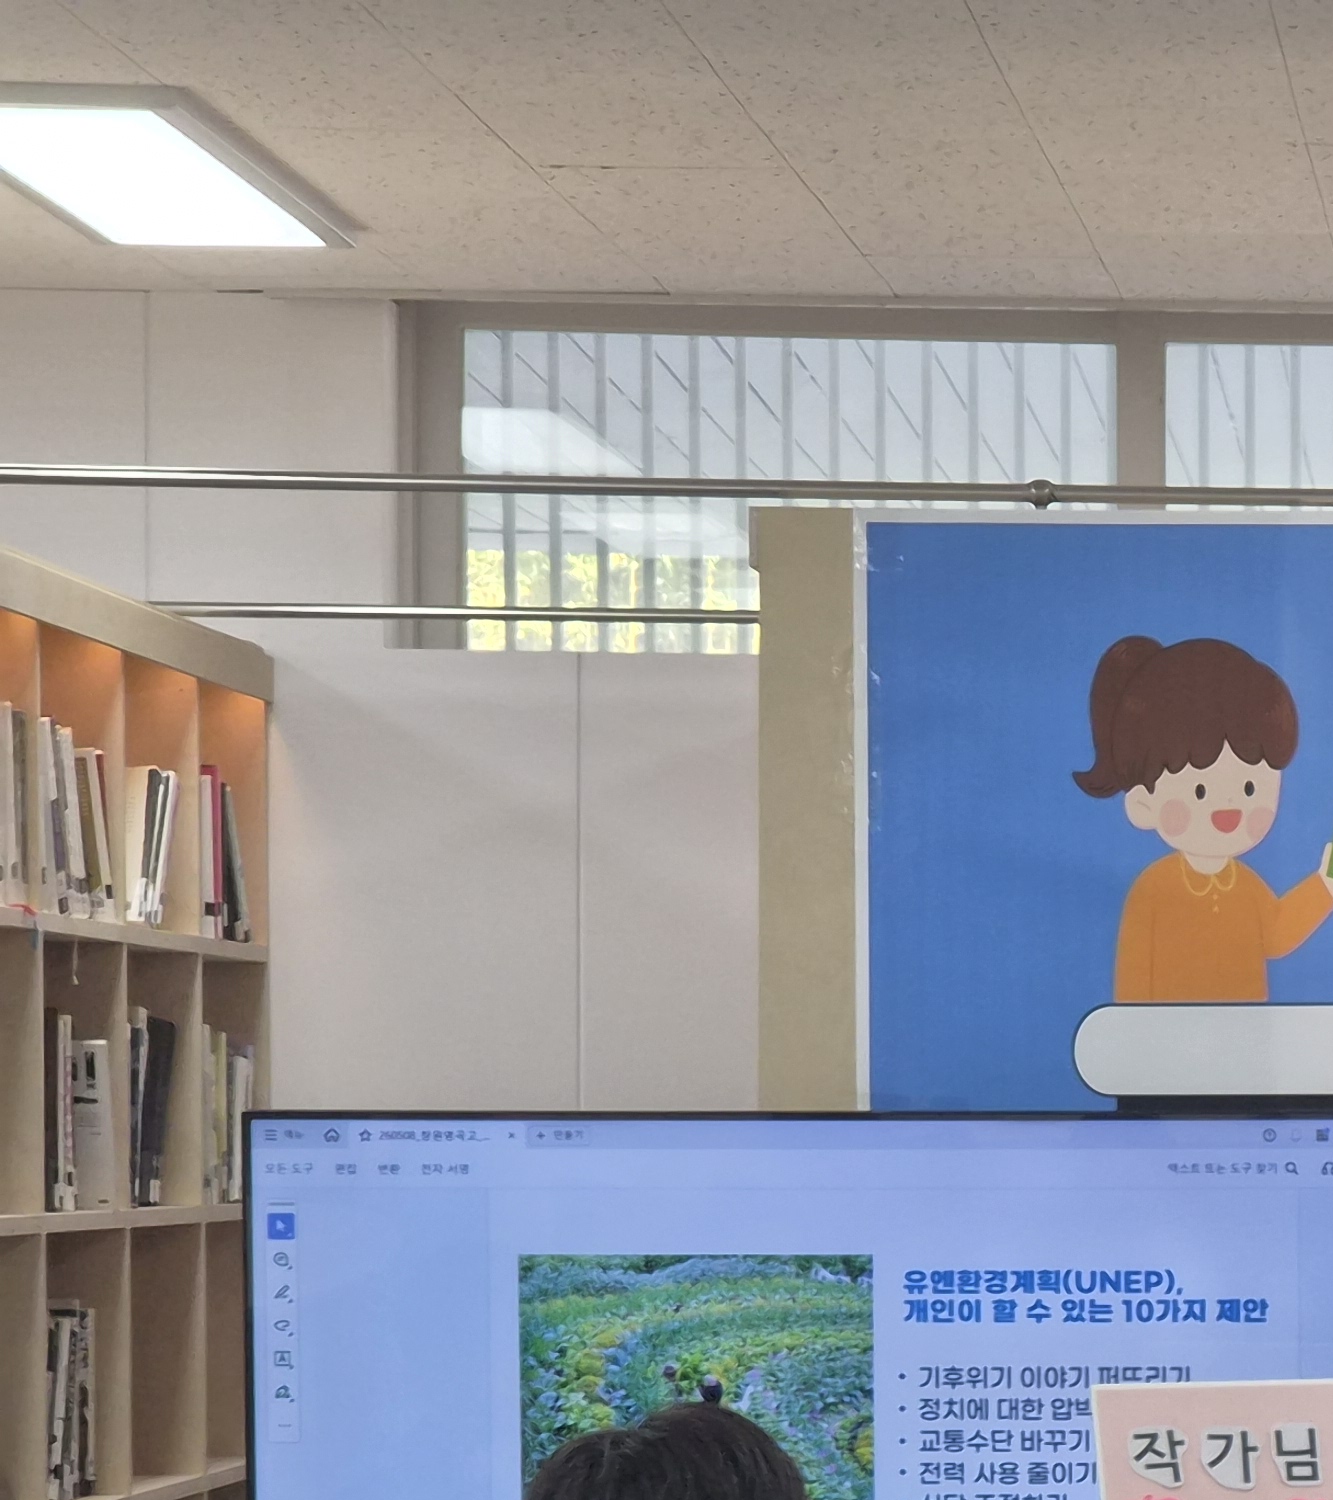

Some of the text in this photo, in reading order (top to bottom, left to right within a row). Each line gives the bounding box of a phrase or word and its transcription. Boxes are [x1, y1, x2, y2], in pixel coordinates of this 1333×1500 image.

[902, 1268, 1185, 1296] 유엔환경계획(UNEP),
[903, 1298, 1270, 1324] 개인이 할 수 있는 10가지 제안
[919, 1365, 1012, 1390] 기후위기
[1020, 1365, 1090, 1389] 이야기
[918, 1397, 989, 1422] 정치에
[996, 1397, 1045, 1421] 대한
[918, 1429, 1091, 1453] 교통수단 바꾸기
[1131, 1425, 1321, 1486] 작가님
[919, 1461, 1097, 1486] 전력 사용 줄이기
